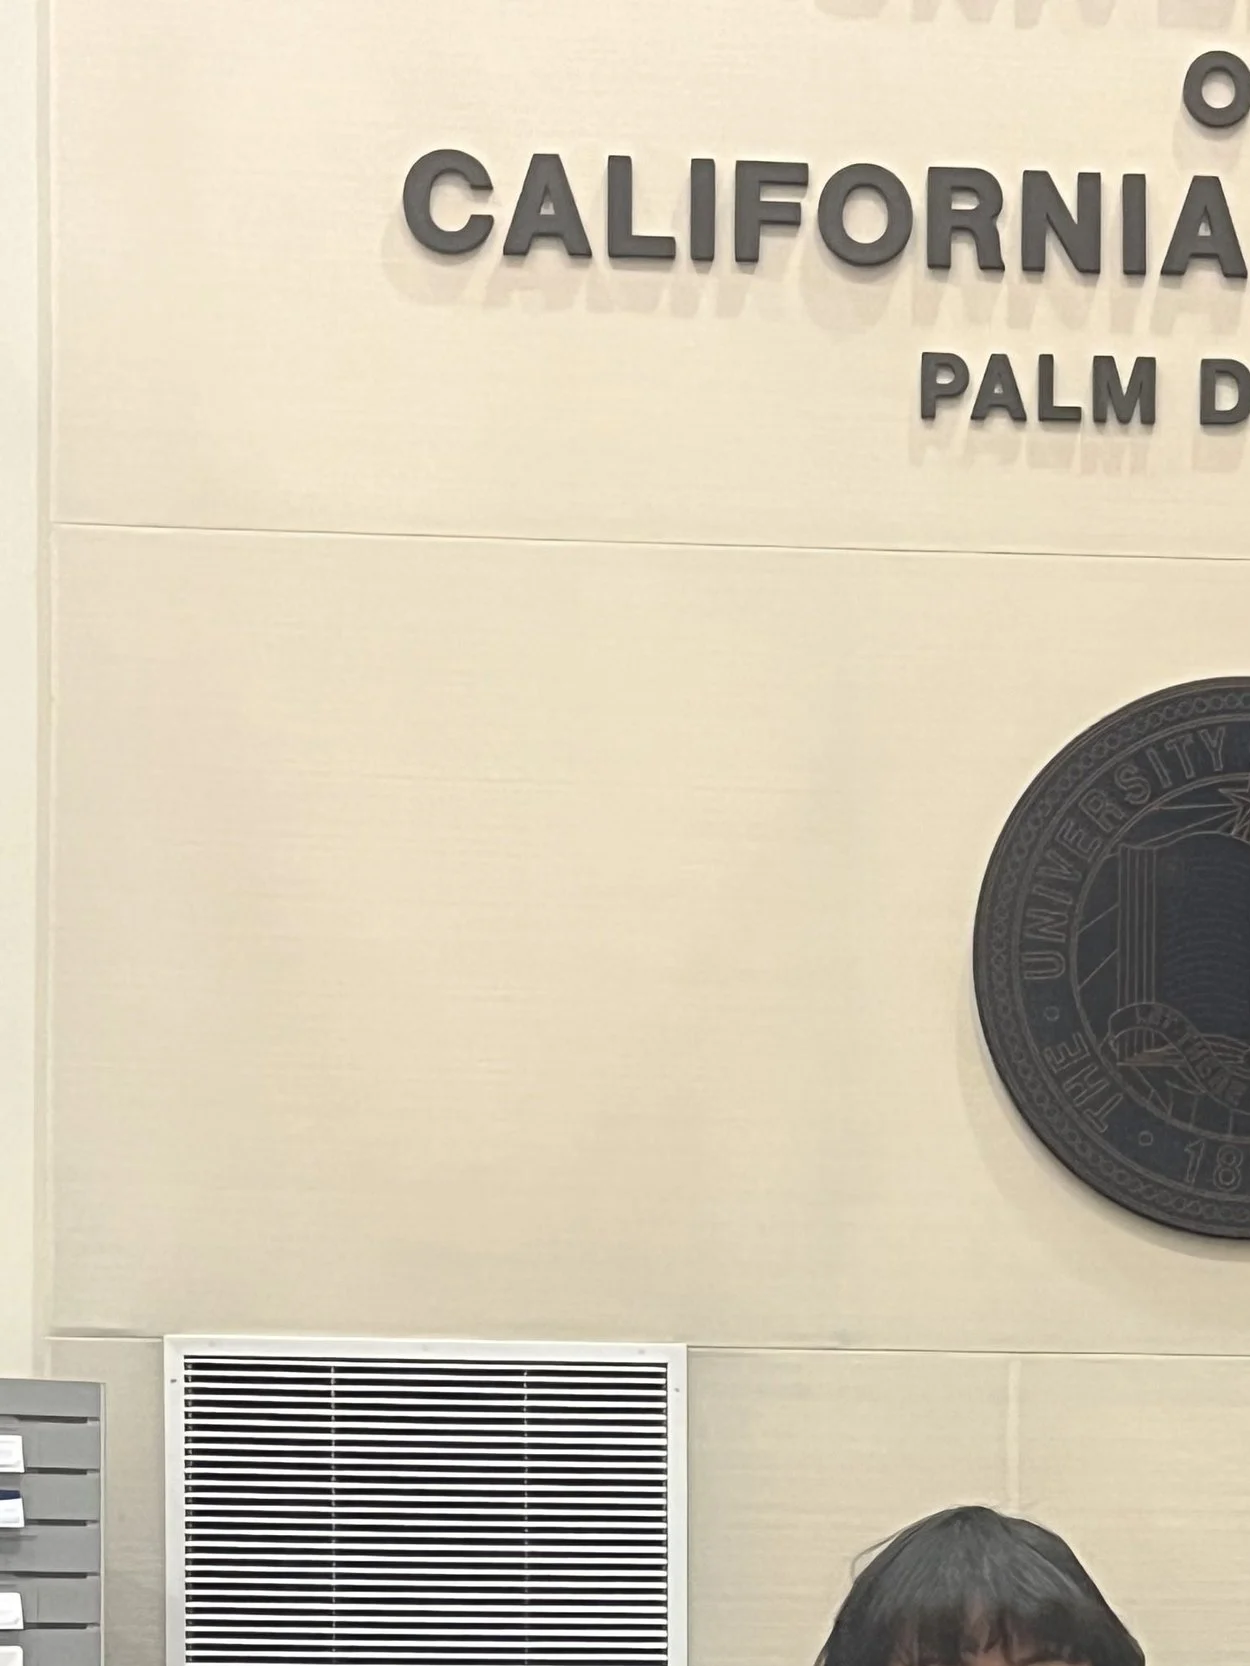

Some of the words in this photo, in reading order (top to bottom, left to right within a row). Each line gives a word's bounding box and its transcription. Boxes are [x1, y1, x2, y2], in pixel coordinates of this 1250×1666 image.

[921, 352, 1156, 426] PALM
[1022, 726, 1227, 981] UNIVERSITY
[1044, 1032, 1124, 1133] THE
